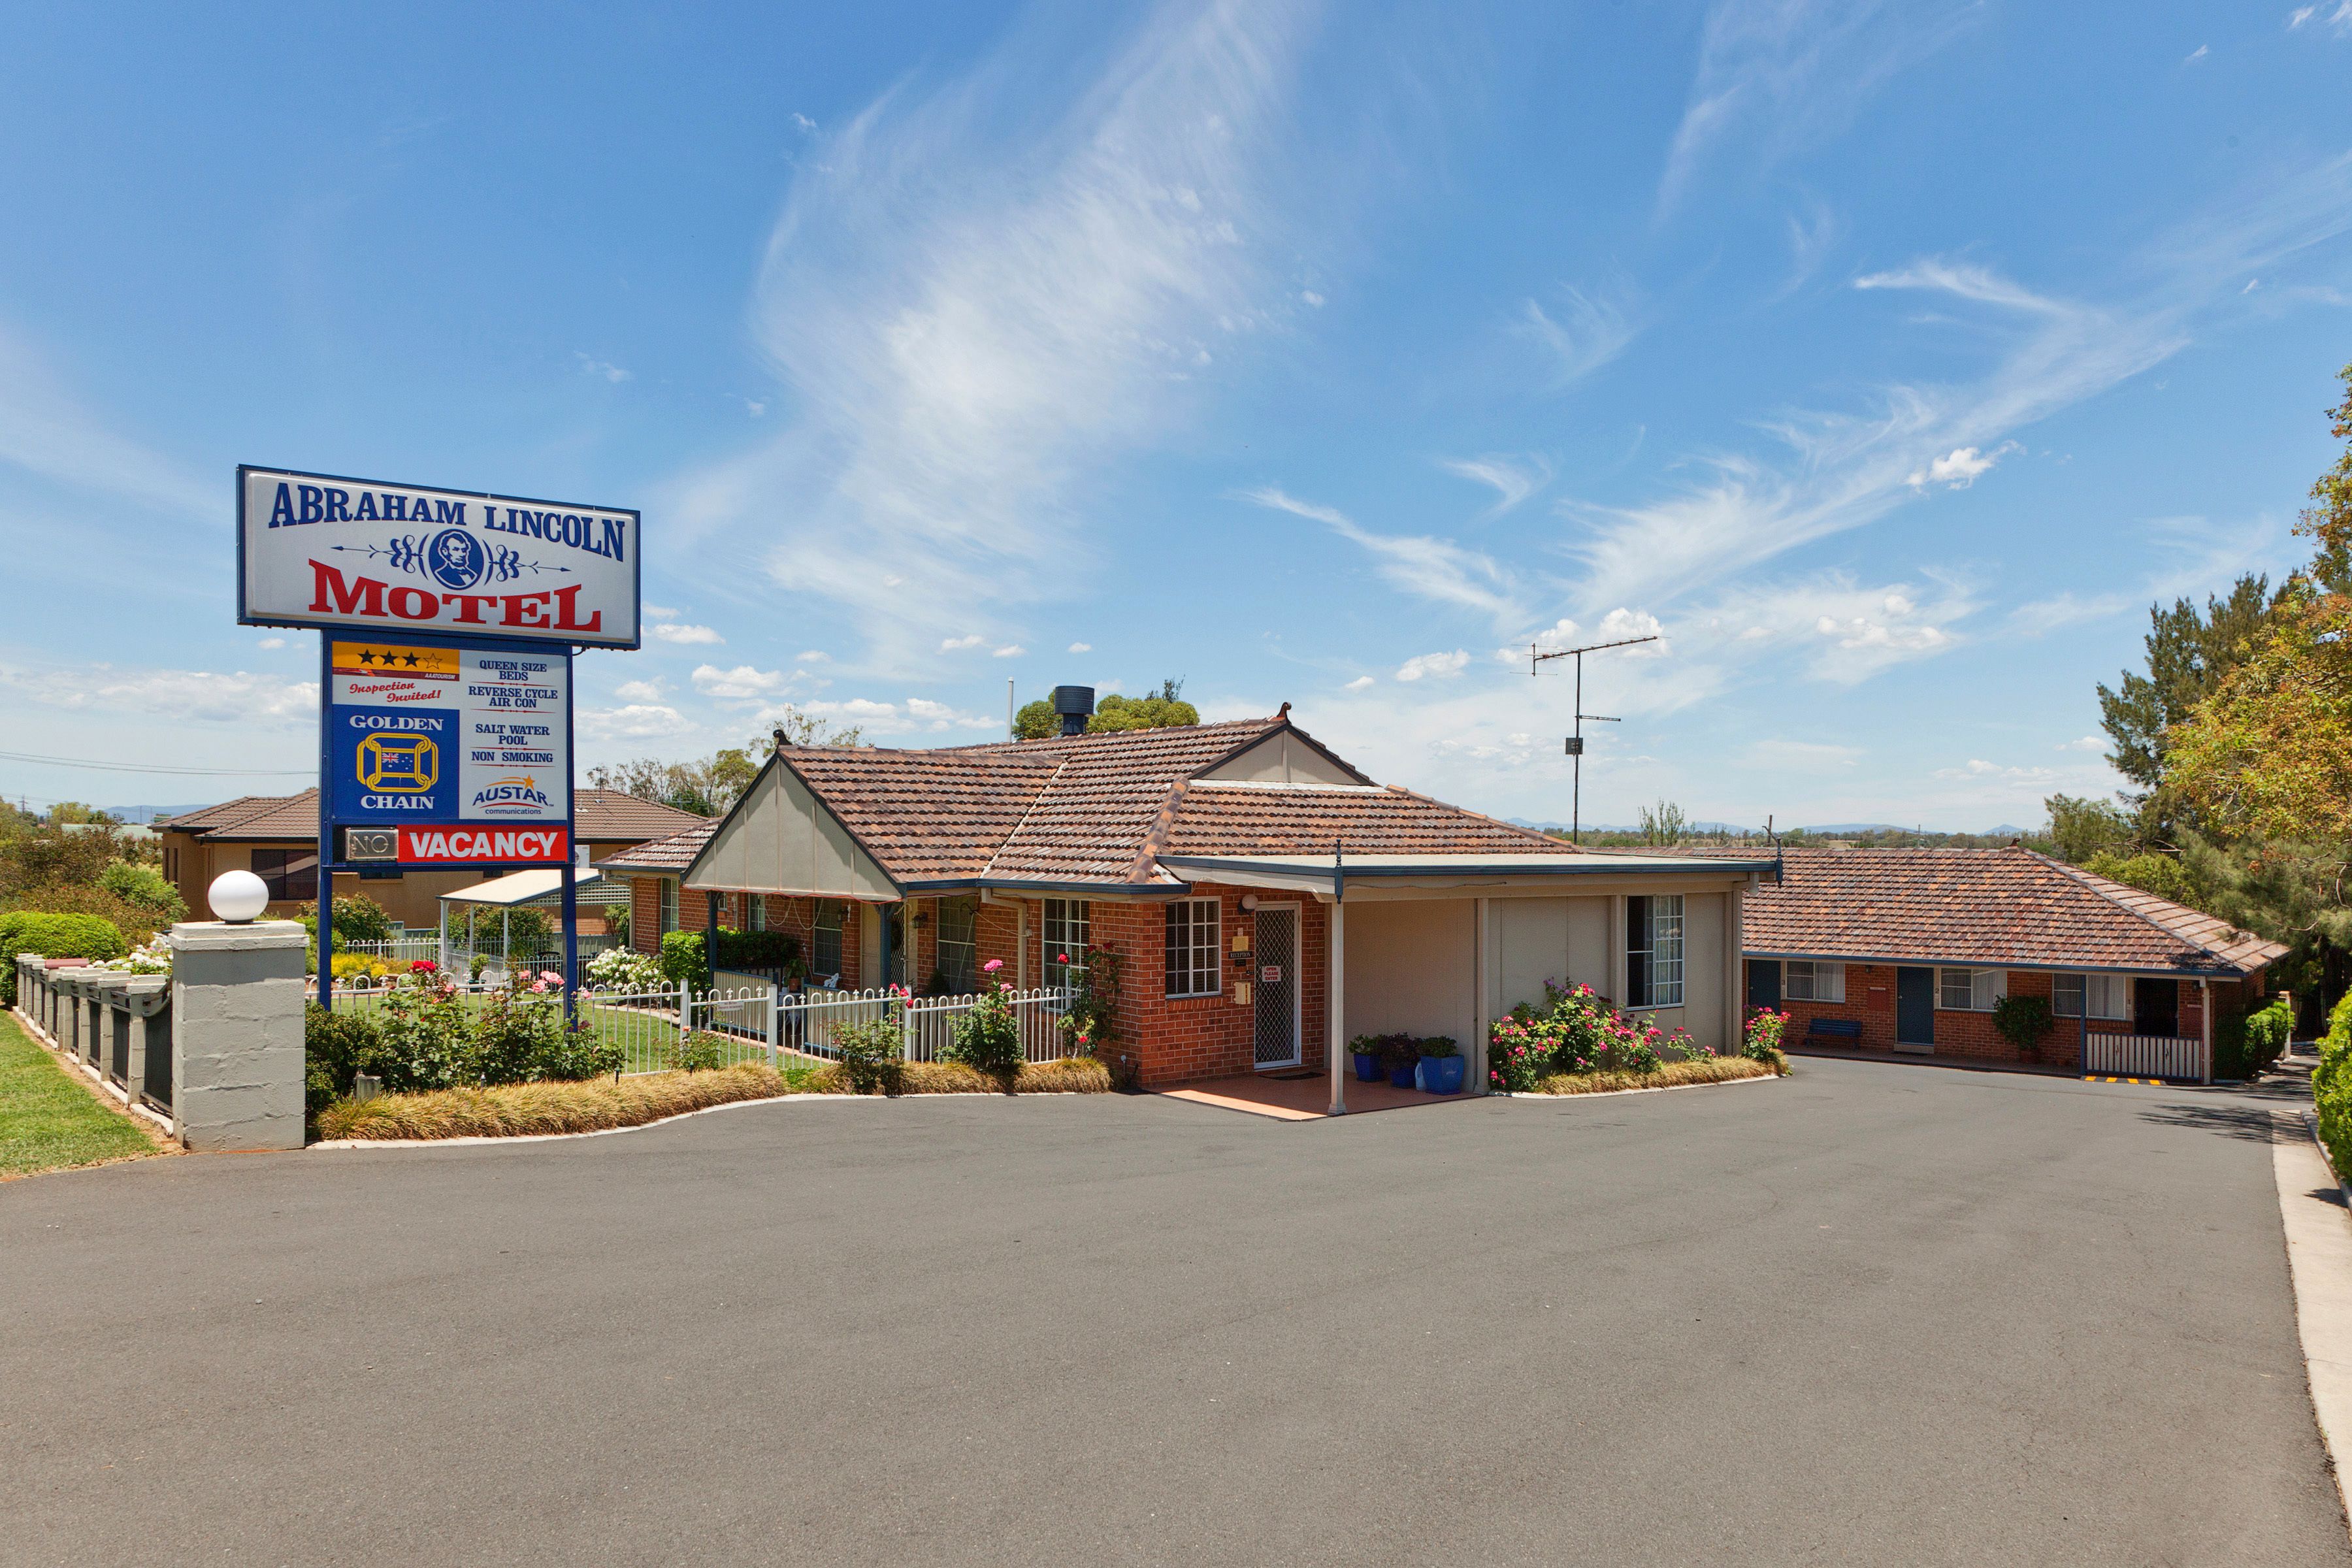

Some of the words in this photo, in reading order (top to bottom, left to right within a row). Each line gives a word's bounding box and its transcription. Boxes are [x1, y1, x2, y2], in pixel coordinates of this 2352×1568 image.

[268, 482, 466, 529] ABRAHAM
[483, 506, 625, 562] LINCOLN
[308, 558, 601, 632] MOTEL
[480, 660, 518, 672] QUEEN
[521, 662, 547, 672] SIZE
[498, 670, 529, 681] BEDS
[350, 681, 416, 694] Inspection
[468, 686, 522, 698] REVERSE
[525, 688, 558, 700] CYCLE
[387, 690, 441, 702] Invited!
[489, 697, 510, 707] AIR
[515, 698, 537, 708] CON
[350, 715, 444, 731] GOLDEN
[476, 723, 505, 734] SALT
[510, 725, 550, 736] WATER
[498, 735, 528, 745] POOL
[472, 751, 495, 762] NON
[502, 752, 553, 763] SMOKING
[360, 795, 435, 809] CHAIN
[472, 787, 548, 806] AUSTAR
[409, 832, 558, 858] VACANCY
